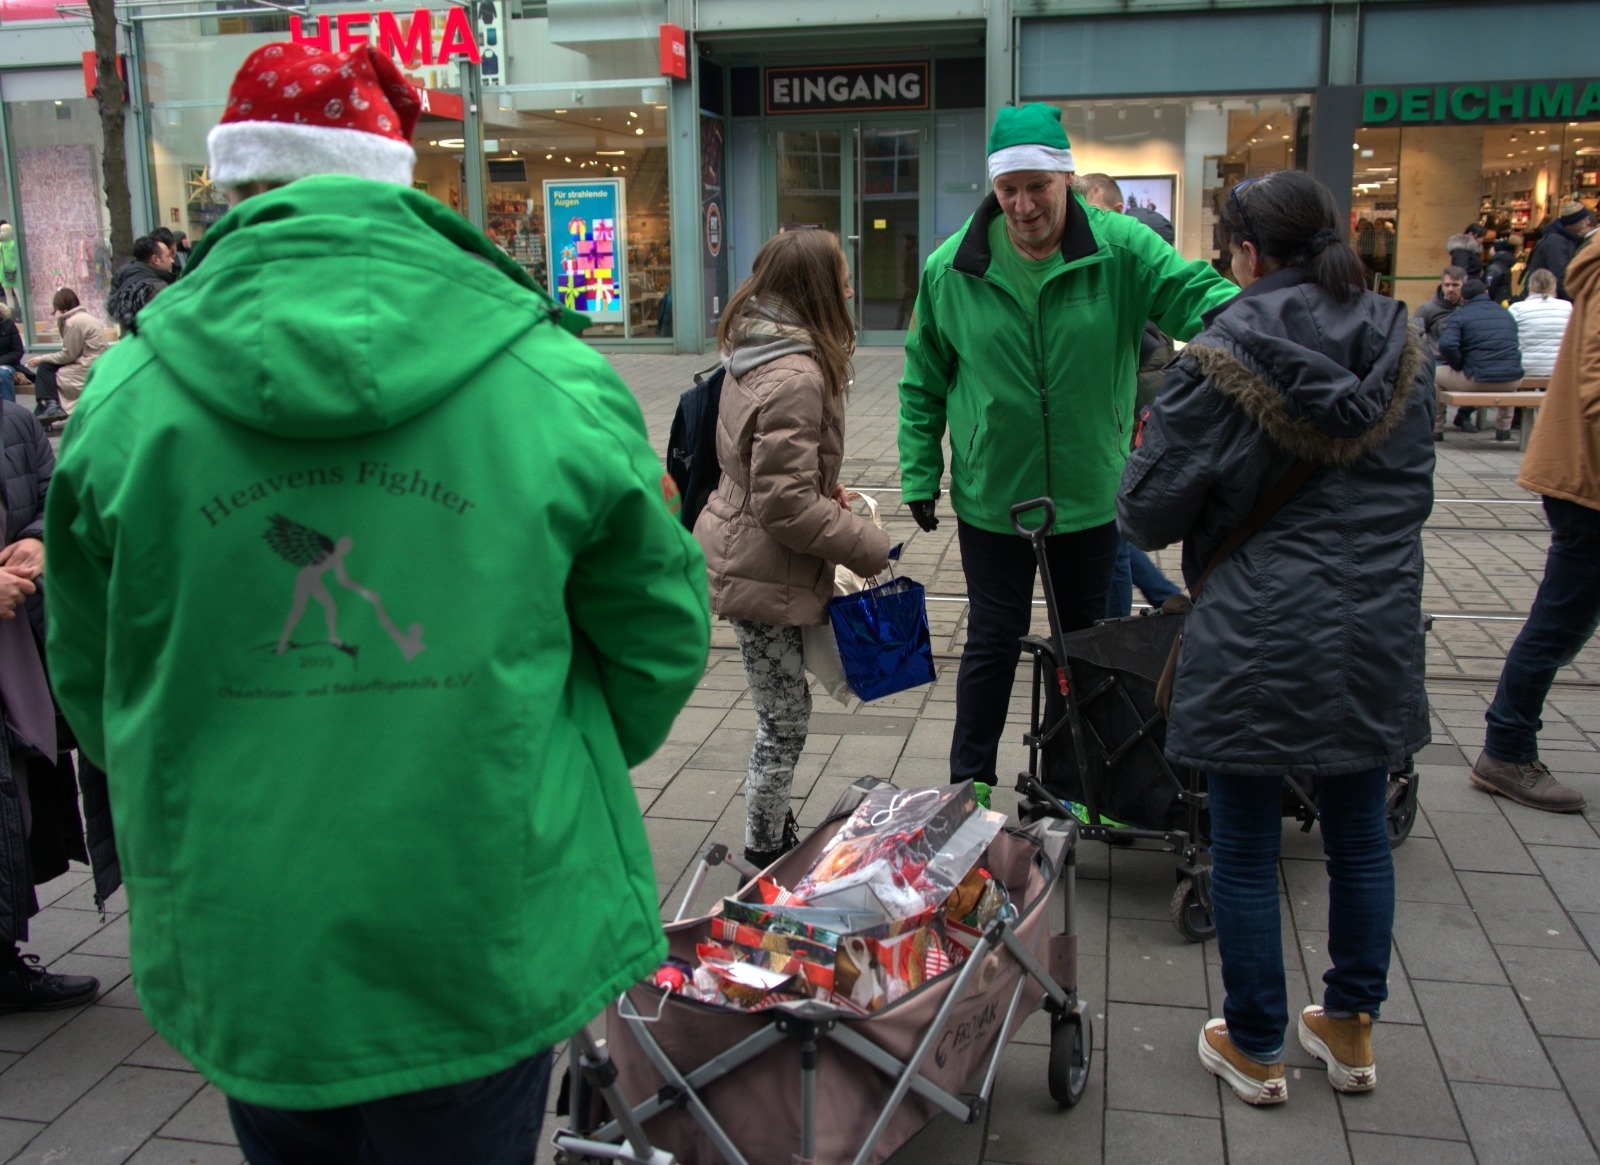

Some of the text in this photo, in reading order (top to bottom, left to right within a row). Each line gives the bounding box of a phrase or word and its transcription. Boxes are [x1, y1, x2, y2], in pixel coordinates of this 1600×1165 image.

[290, 6, 482, 66] HEMA
[773, 73, 921, 104] EINGANG
[554, 190, 608, 199] Für strahlende
[554, 198, 579, 207] Augen
[199, 460, 475, 528] Heavens Fighter
